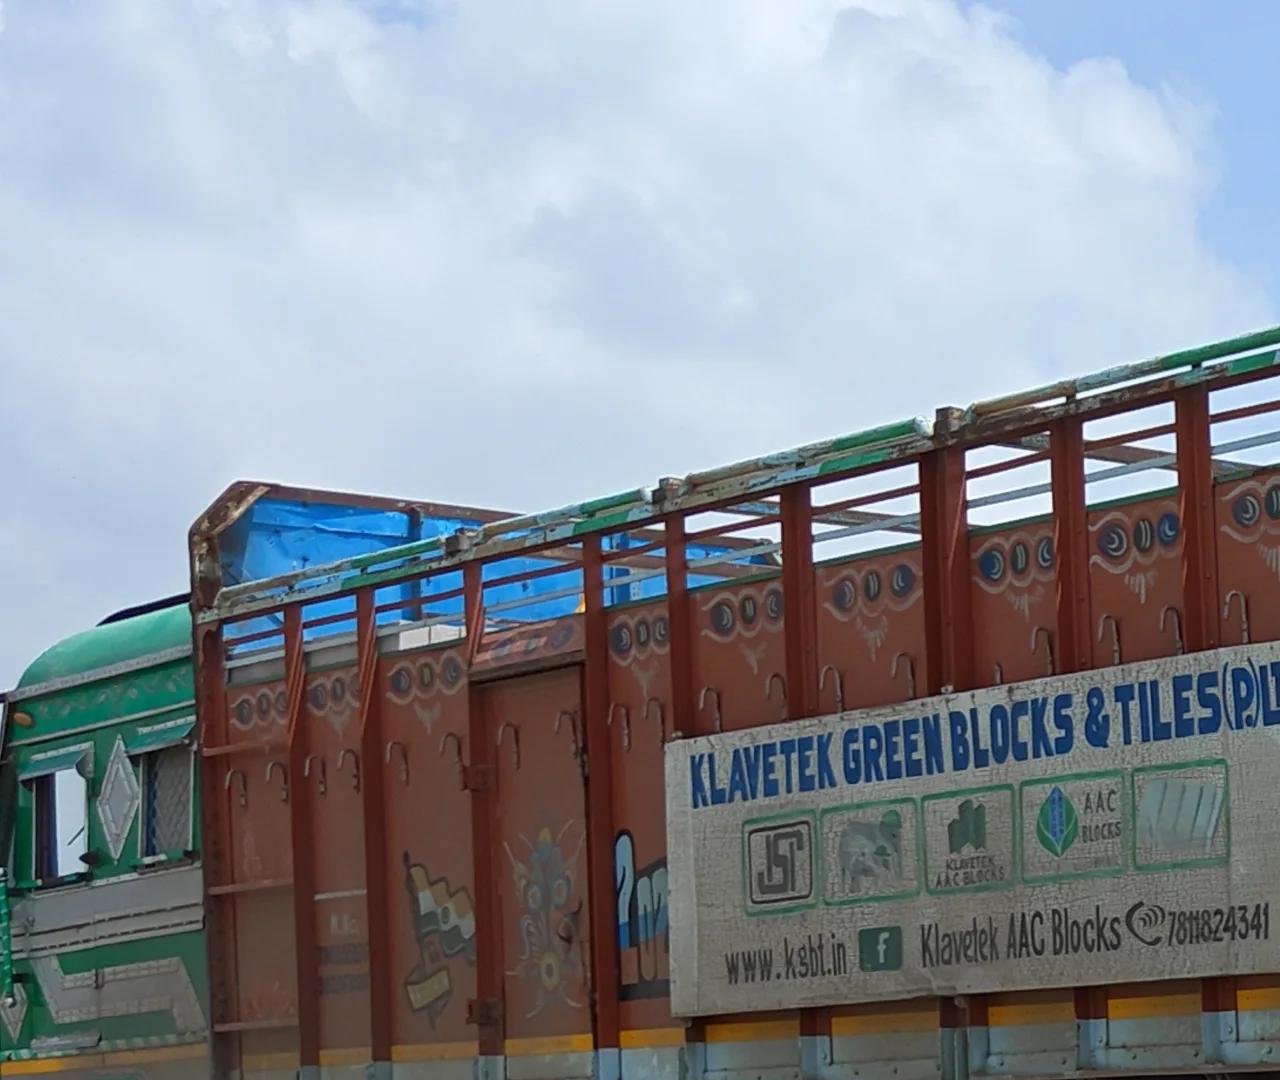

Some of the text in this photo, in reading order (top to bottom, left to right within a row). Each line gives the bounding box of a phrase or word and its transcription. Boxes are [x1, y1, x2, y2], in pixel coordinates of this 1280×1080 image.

[689, 732, 837, 809] KLAVETEK
[843, 713, 944, 785] GREEN
[949, 694, 1074, 772] BLOCKS
[1085, 687, 1110, 748] &
[1083, 789, 1117, 814] AAC
[1082, 821, 1122, 843] BLOCKS
[935, 866, 1005, 889] AAC BLOCKS
[921, 905, 1121, 968] Klavetek AAC Blocks
